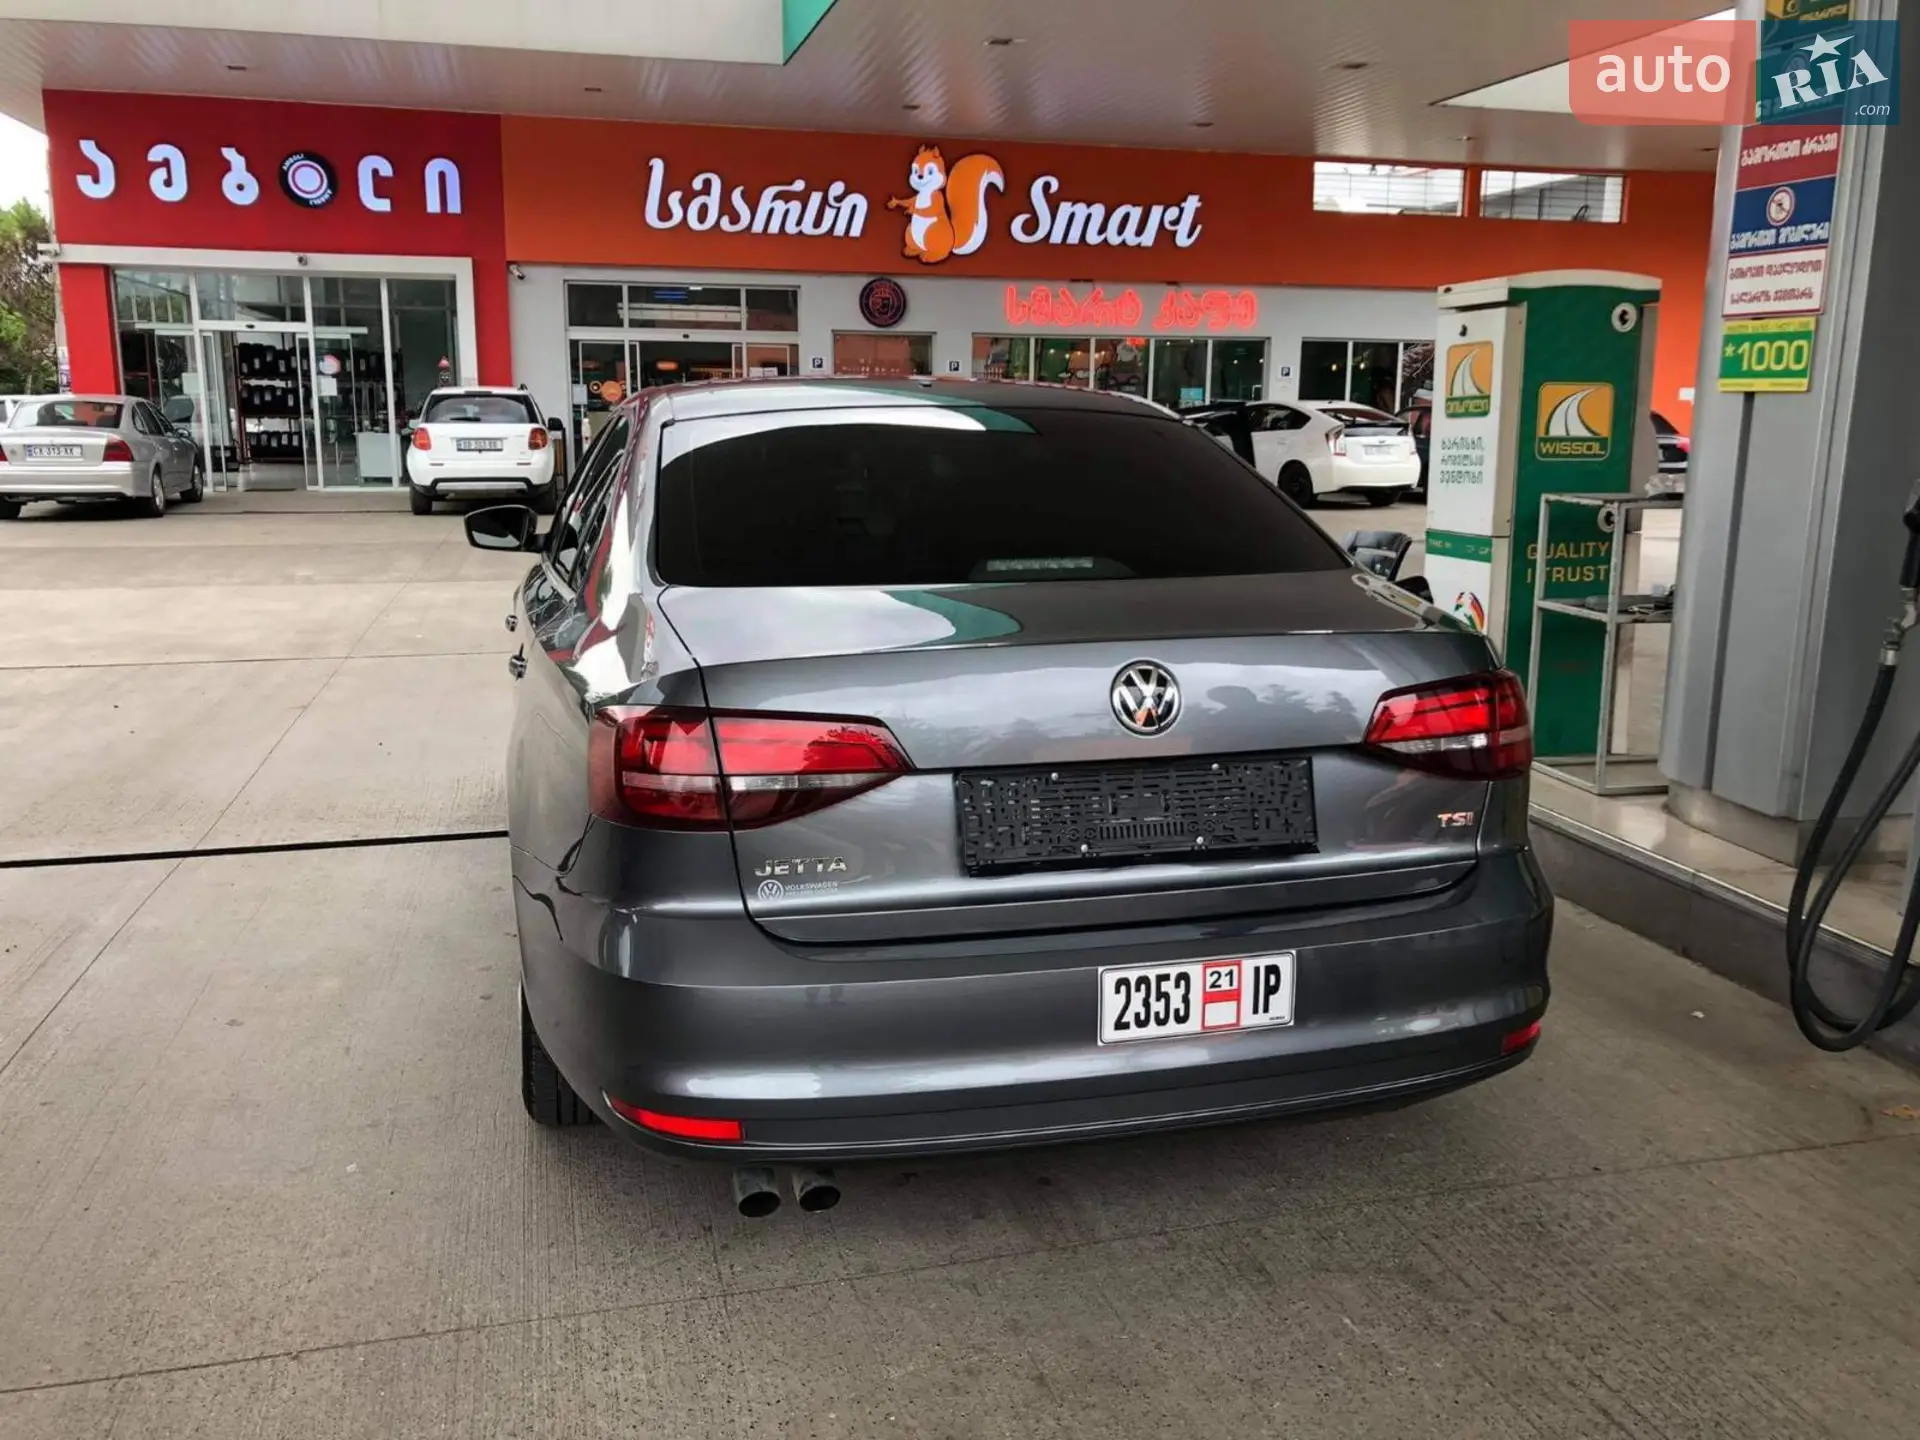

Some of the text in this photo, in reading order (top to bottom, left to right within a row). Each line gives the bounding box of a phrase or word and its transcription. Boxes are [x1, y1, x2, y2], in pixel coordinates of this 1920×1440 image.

[1010, 175, 1202, 248] Smart
[1540, 440, 1605, 455] WISSOL
[1437, 811, 1474, 828] TSI
[755, 857, 847, 876] JETTA
[784, 881, 839, 892] VOLKSWAGEN
[1114, 964, 1281, 1031] 2353 21 IP
